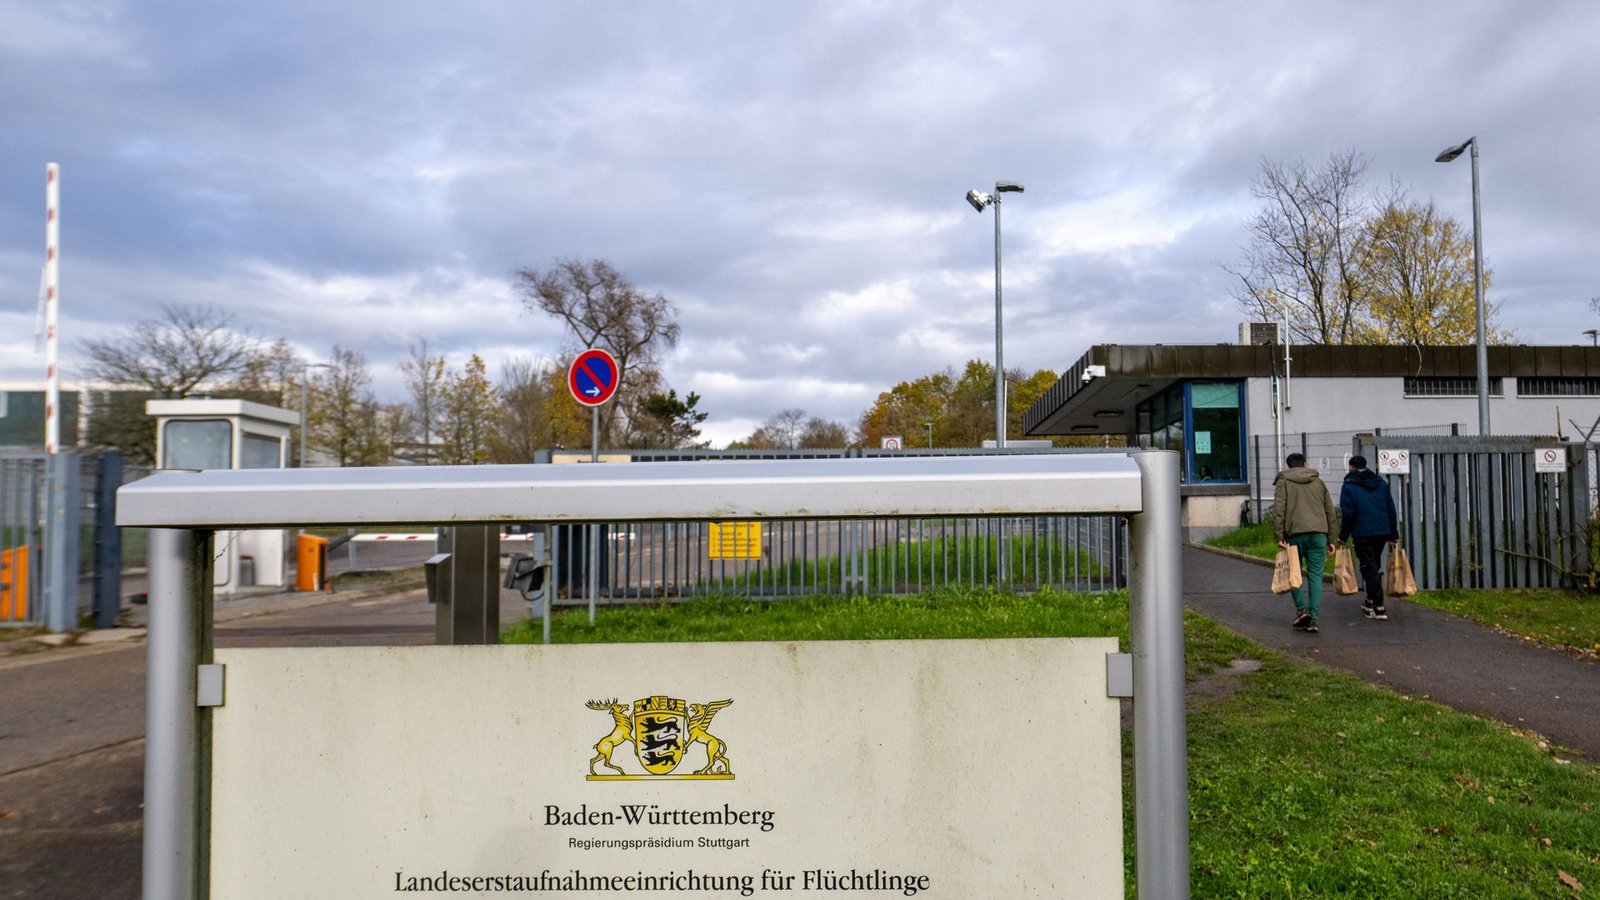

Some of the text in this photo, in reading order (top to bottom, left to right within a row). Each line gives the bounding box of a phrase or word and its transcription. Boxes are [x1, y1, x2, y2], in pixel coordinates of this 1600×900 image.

[544, 804, 775, 832] Baden-Württemberg
[569, 837, 749, 850] Regierungspräsidium Stuttgart
[395, 869, 930, 896] Landeserstaufnahmeeinrichtung für Flüchtlinge
